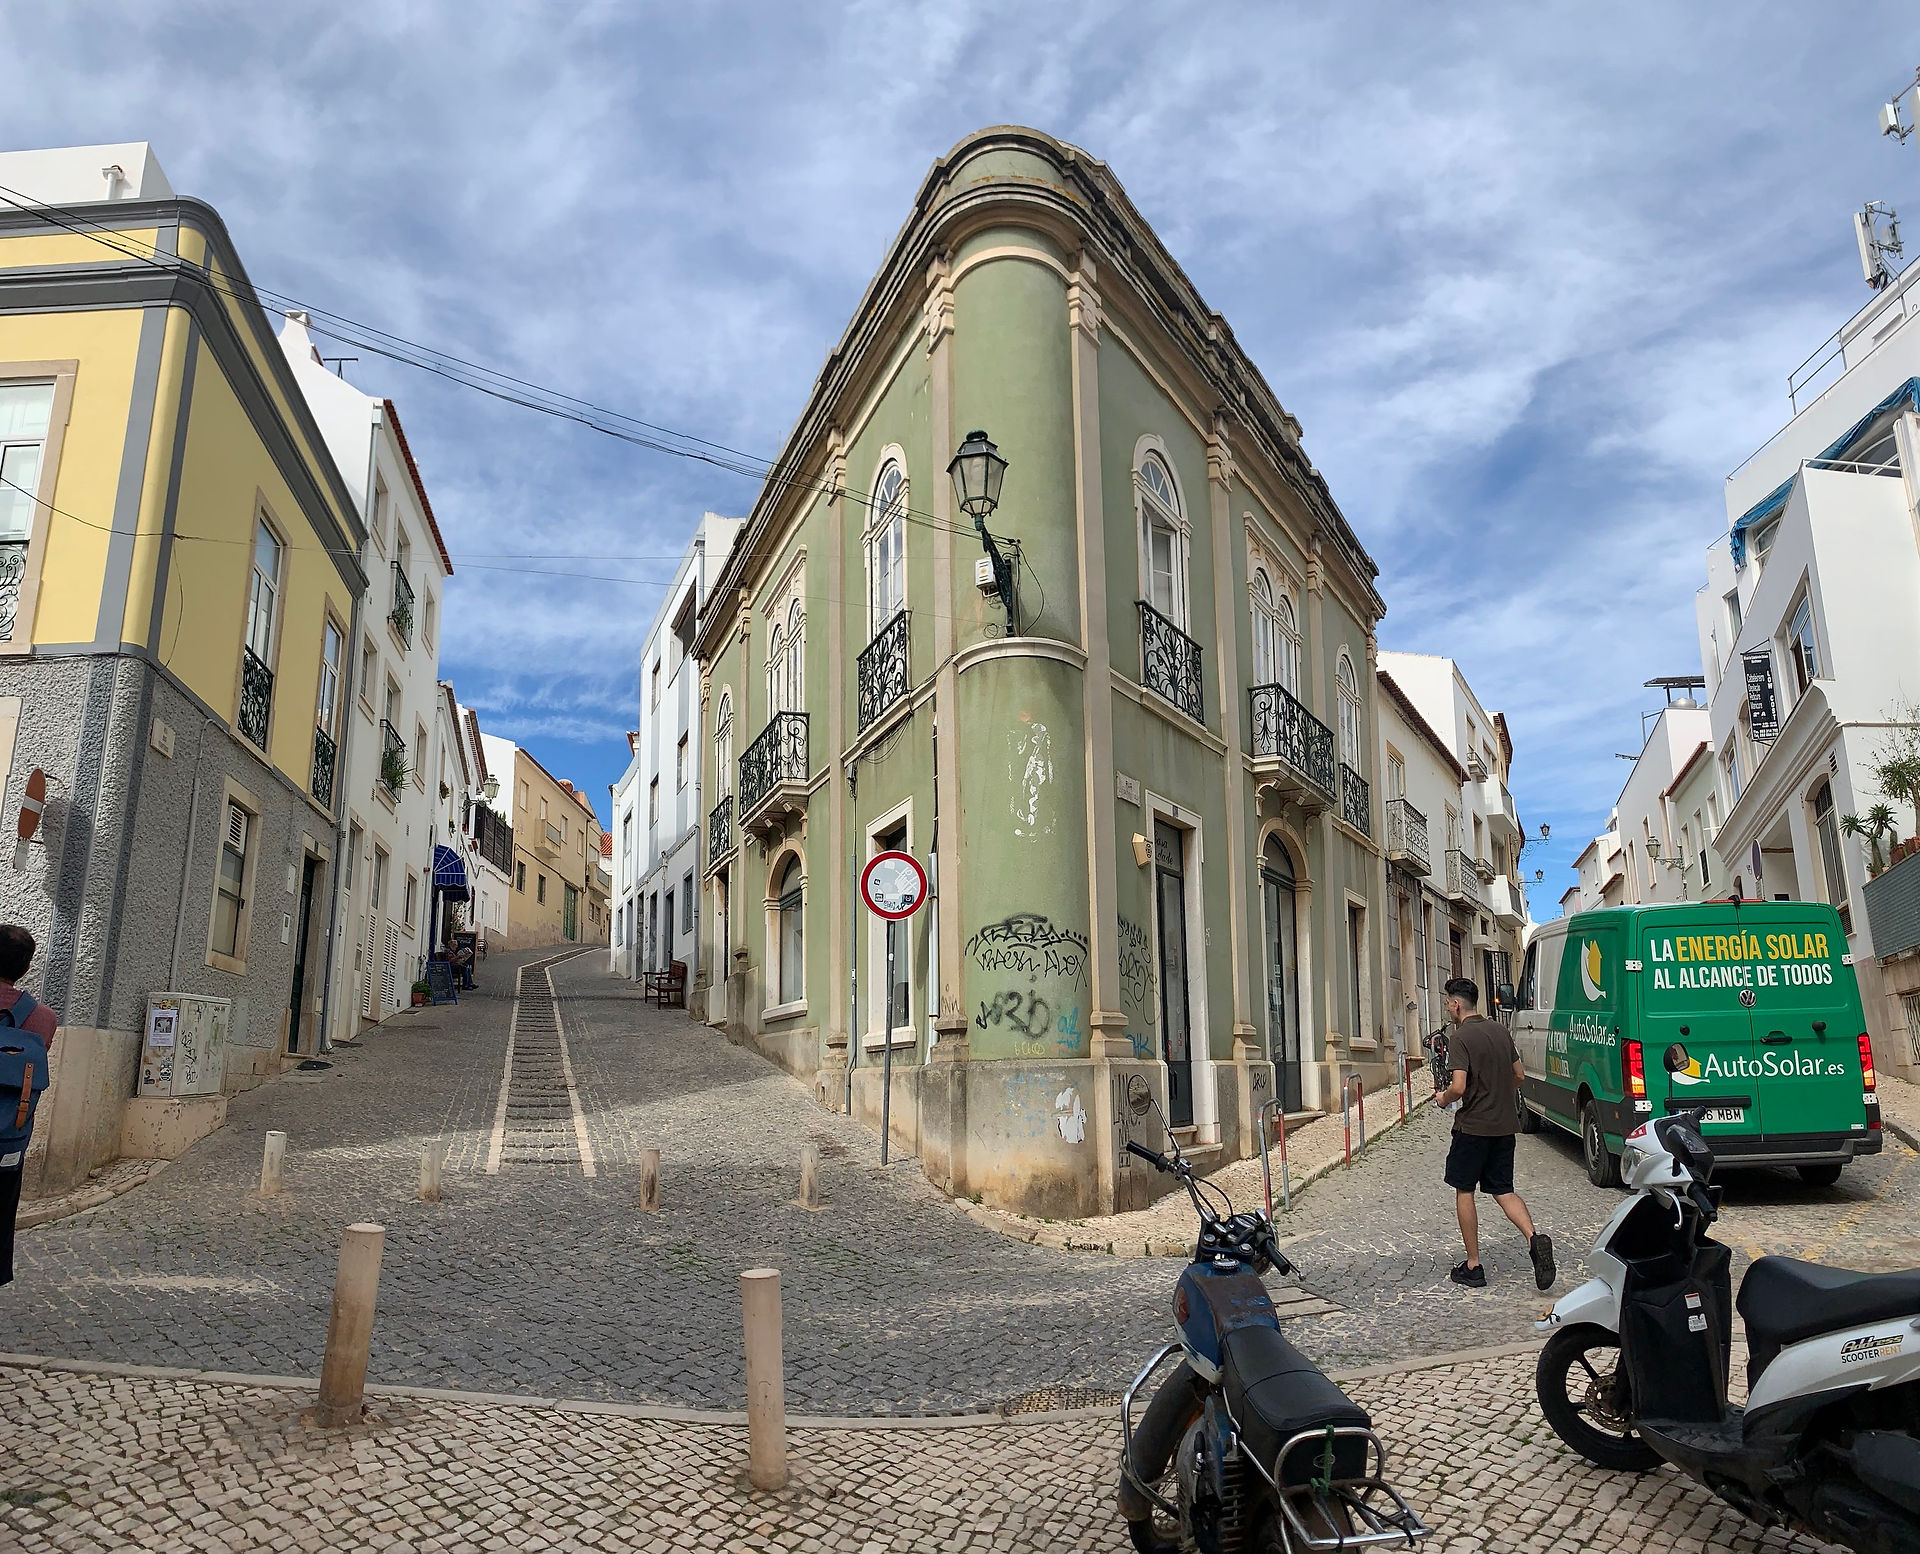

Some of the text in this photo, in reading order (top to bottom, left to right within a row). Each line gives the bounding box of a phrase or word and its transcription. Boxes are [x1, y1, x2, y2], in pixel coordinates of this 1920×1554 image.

[1769, 694, 1777, 720] COST
[1650, 930, 1830, 962] LA ENERGÍA SOLAR
[1654, 963, 1833, 989] AL ALCANCE DE TODOS
[1569, 1014, 1616, 1047] AutoSolar.es
[1704, 1049, 1845, 1078] AutoSolar.es
[1717, 1109, 1742, 1121] MBM
